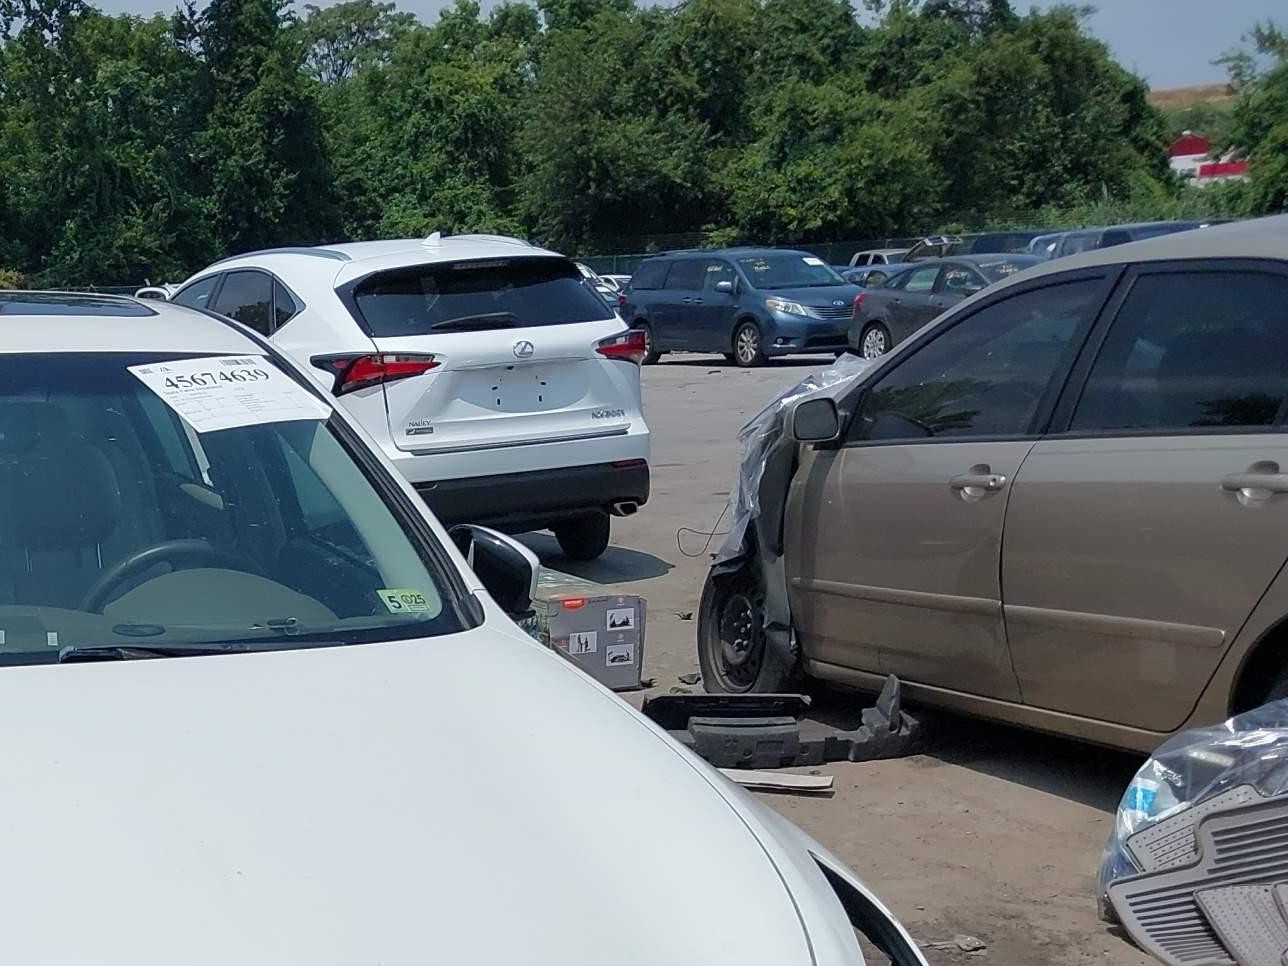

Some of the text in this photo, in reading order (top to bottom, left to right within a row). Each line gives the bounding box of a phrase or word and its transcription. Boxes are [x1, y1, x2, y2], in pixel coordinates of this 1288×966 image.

[164, 368, 270, 389] 45674639
[386, 593, 426, 610] 5 25
